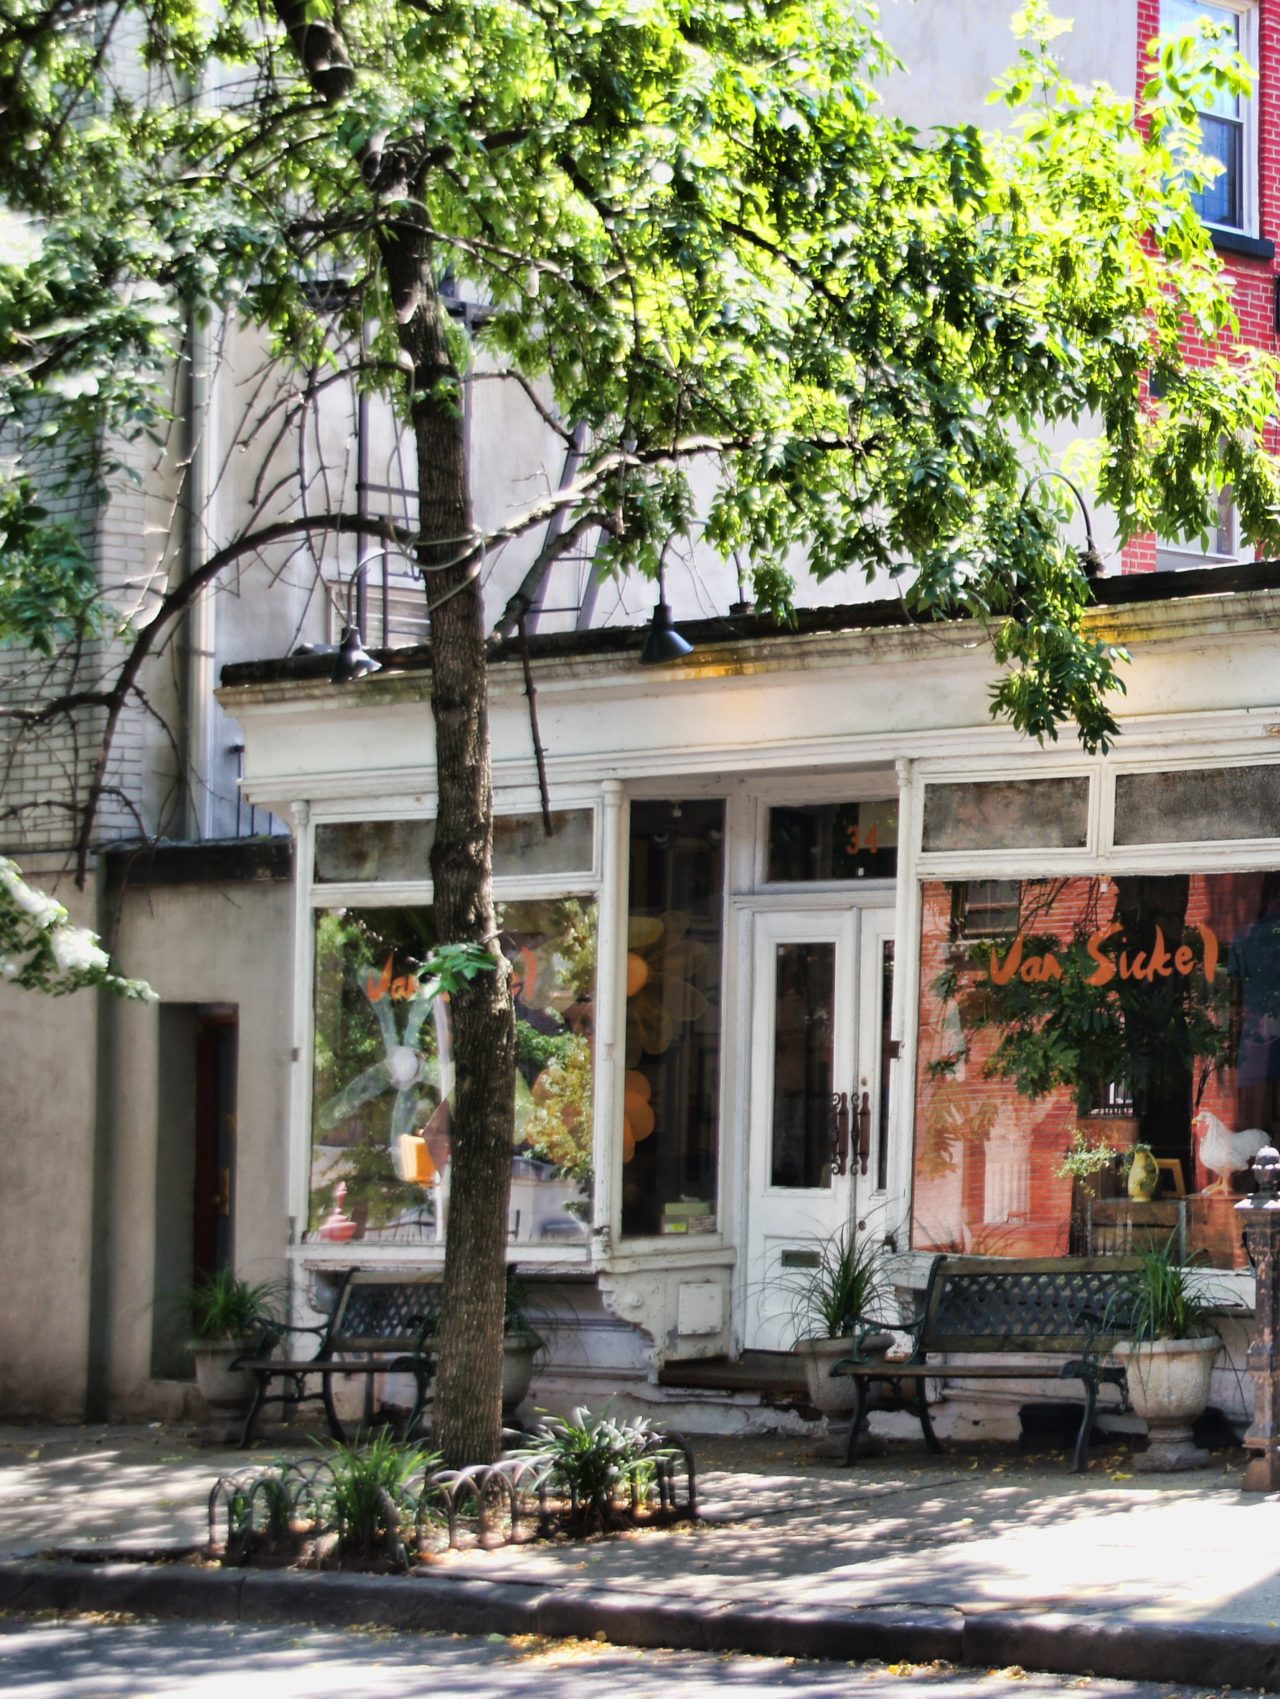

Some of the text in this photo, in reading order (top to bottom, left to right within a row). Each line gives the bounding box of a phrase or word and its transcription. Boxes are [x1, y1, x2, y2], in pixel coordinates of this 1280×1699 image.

[847, 823, 878, 854] 34
[989, 921, 1219, 986] Van Sickel
